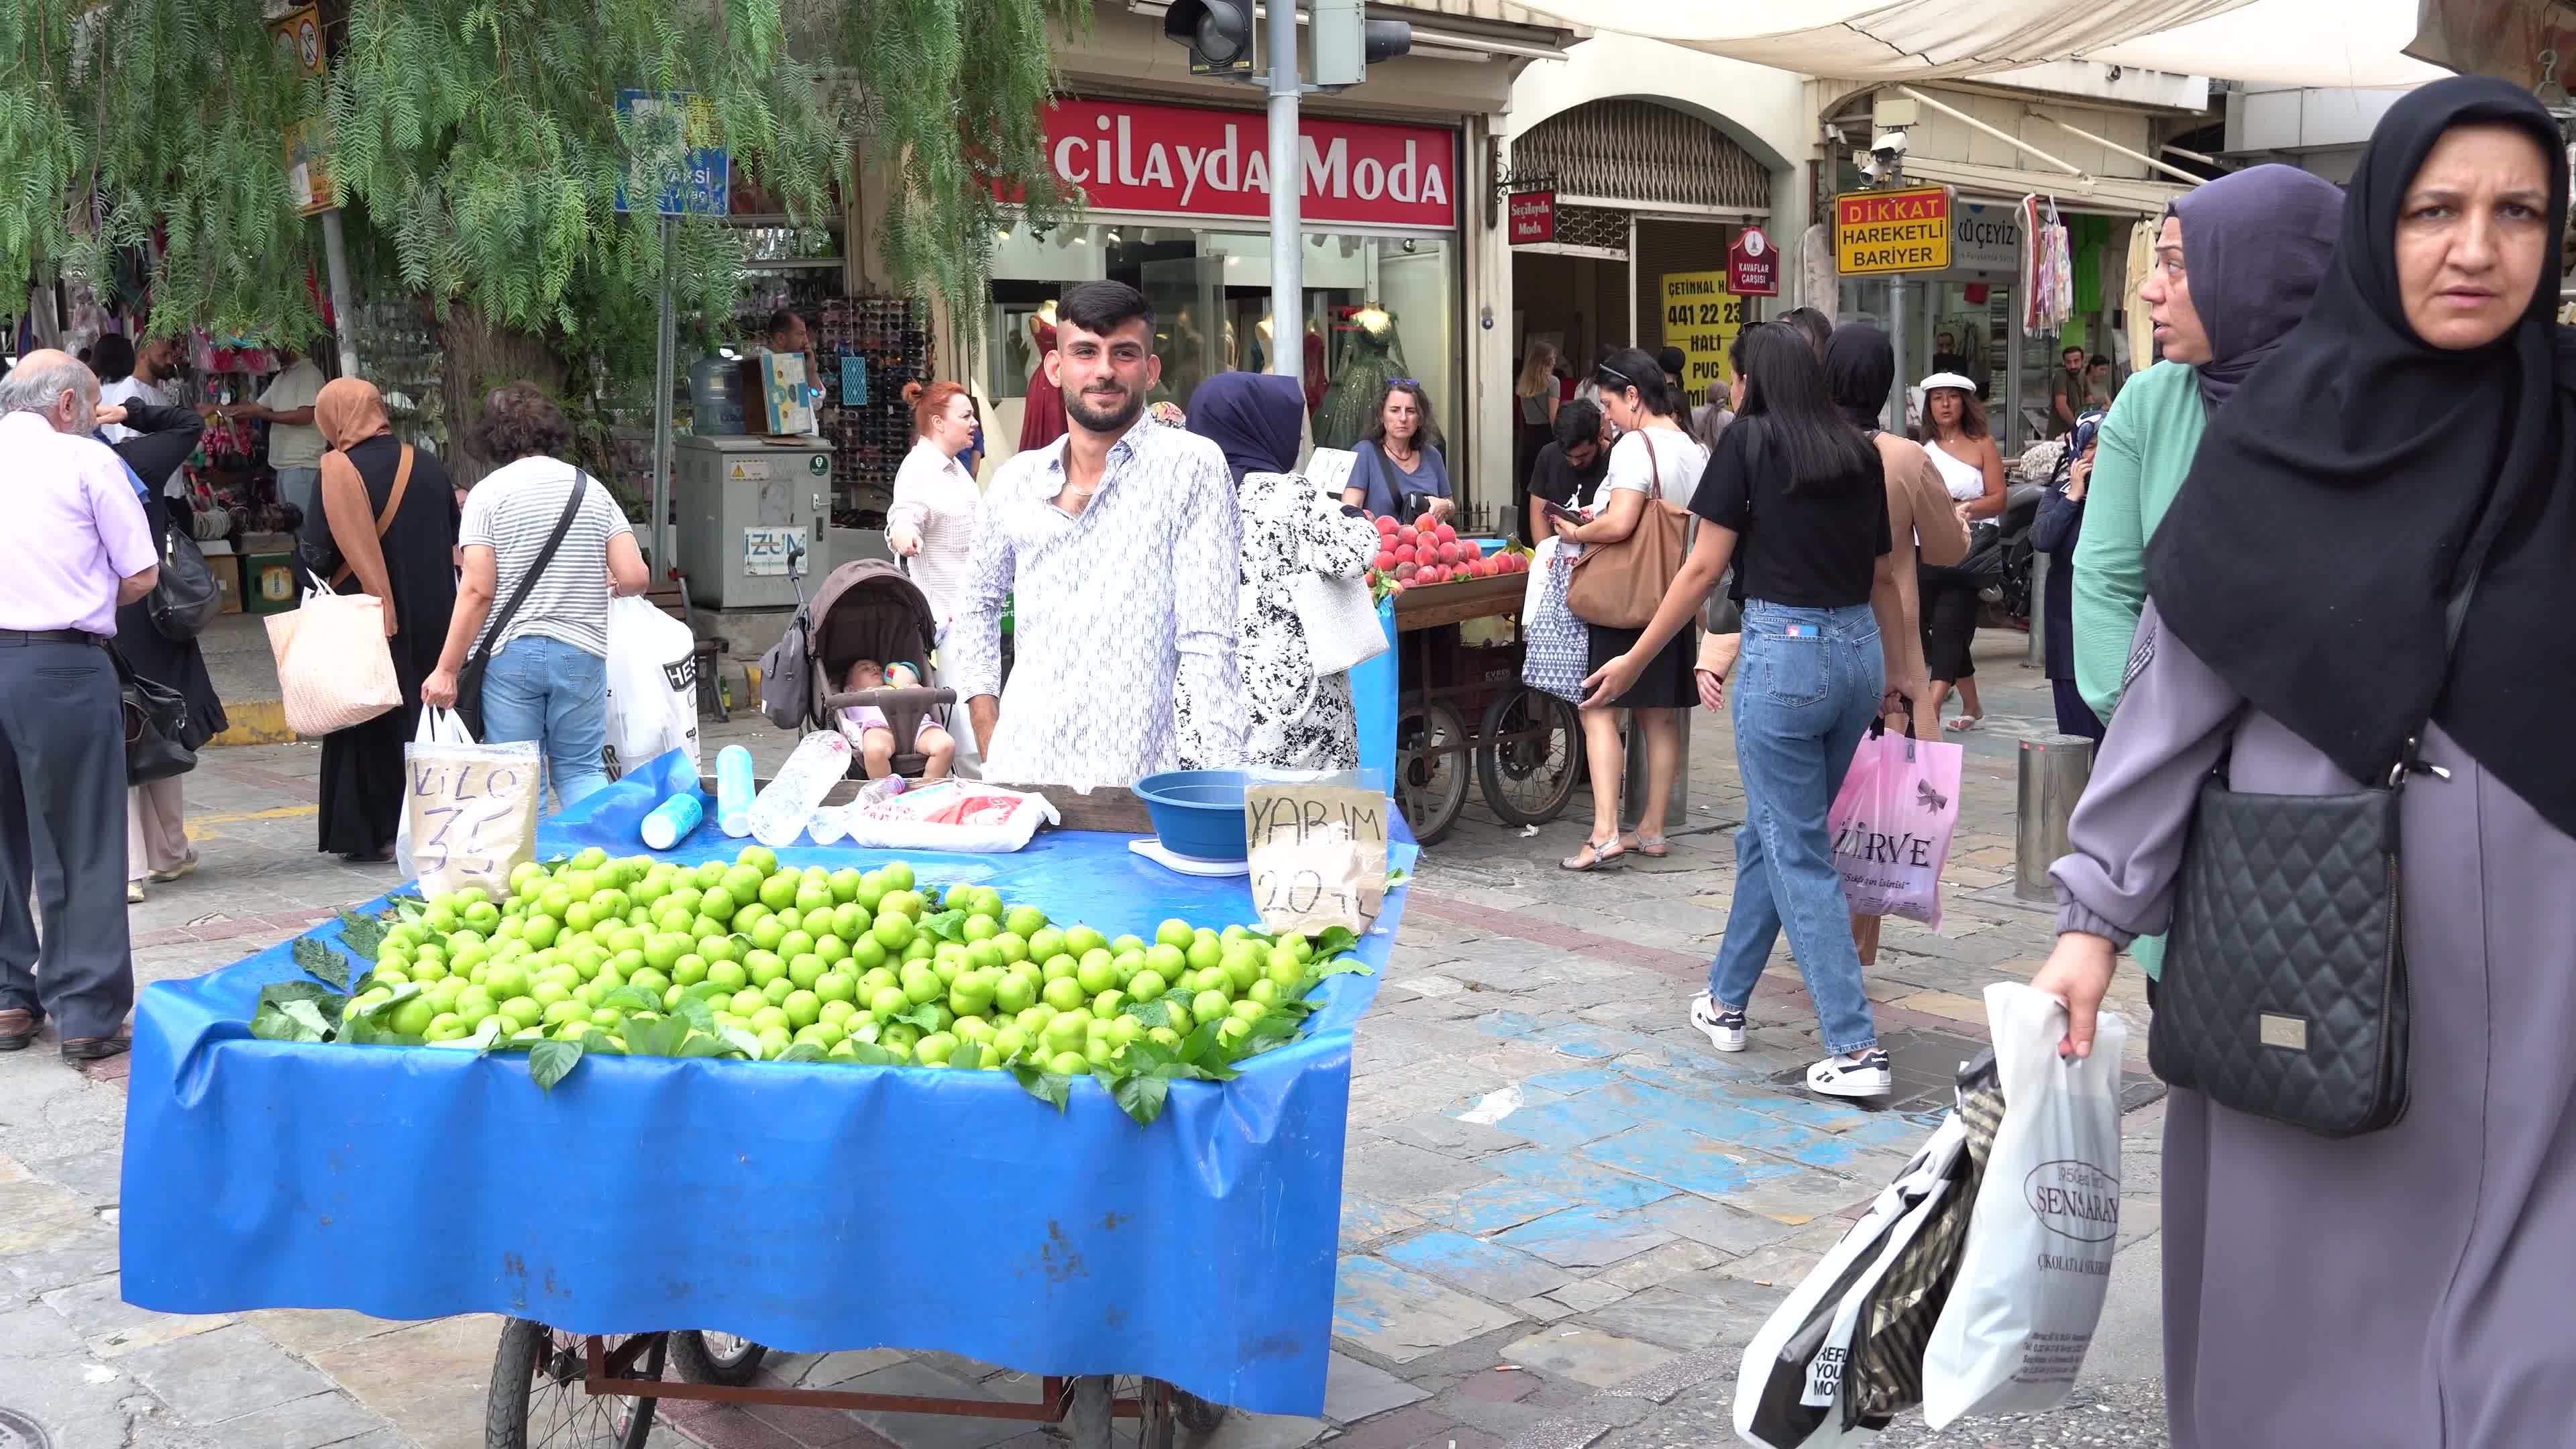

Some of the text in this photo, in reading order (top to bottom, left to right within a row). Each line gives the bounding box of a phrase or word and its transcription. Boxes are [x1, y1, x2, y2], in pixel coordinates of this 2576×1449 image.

[1849, 200, 1939, 223] DİKKAT
[1843, 220, 1943, 245] HAREKETLİ
[1976, 219, 2014, 249] ÇEYİZ
[1738, 262, 1769, 273] KAVAFLAR
[1854, 247, 1933, 266] BARİYER
[1718, 280, 1727, 292] H
[1668, 305, 1695, 326] 441
[1700, 303, 1719, 325] 22
[1250, 797, 1381, 849] YARIM
[421, 805, 515, 875] 35
[1258, 870, 1322, 914] 20
